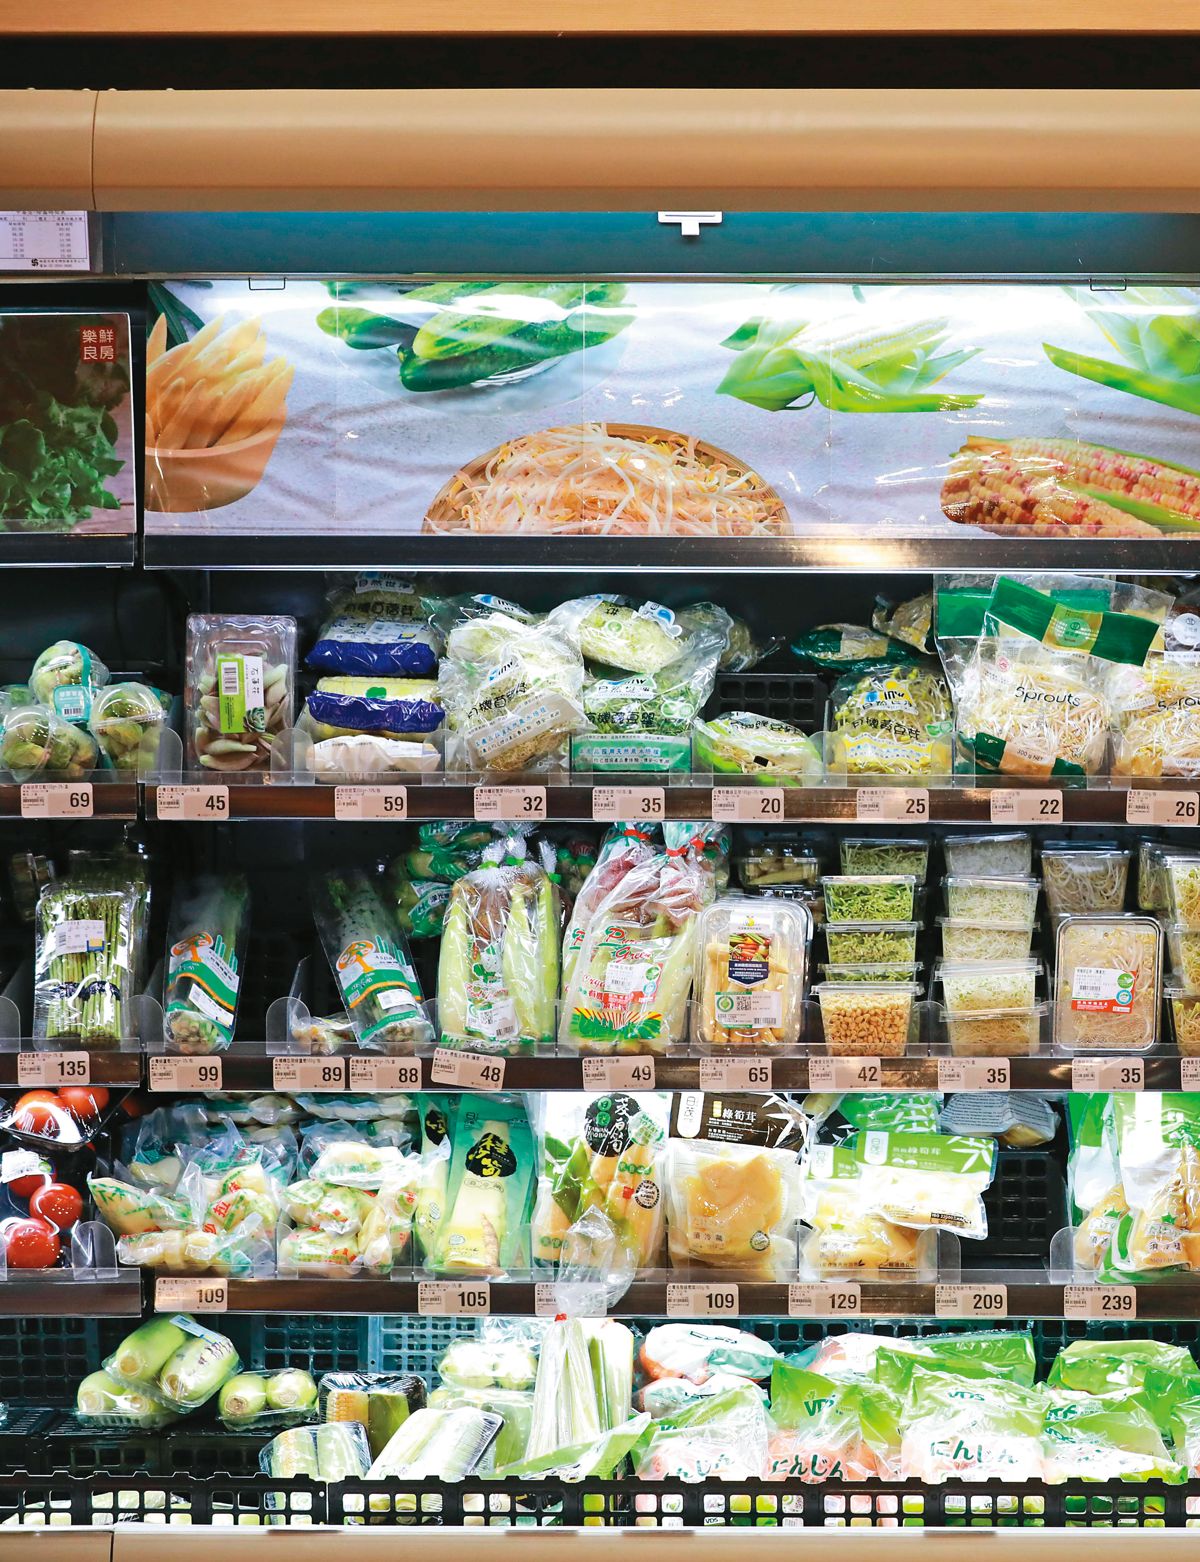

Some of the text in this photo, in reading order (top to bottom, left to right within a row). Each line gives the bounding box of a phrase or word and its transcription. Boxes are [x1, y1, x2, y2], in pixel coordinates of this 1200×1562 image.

[1015, 686, 1082, 707] Sprouts
[69, 792, 90, 808] 69
[205, 795, 226, 811] 45
[383, 796, 404, 812] 59
[523, 795, 543, 812] 32
[641, 797, 662, 814] 35
[760, 797, 781, 814] 20
[905, 798, 926, 814] 25
[1039, 799, 1060, 815] 22
[1175, 800, 1196, 817] 26
[57, 1060, 88, 1077] 135
[198, 1065, 219, 1082] 99
[322, 1066, 343, 1082] 89
[398, 1067, 419, 1084] 88
[479, 1065, 502, 1083] 48
[631, 1065, 652, 1081] 49
[748, 1067, 769, 1083] 65
[857, 1066, 878, 1082] 42
[986, 1068, 1007, 1084] 35
[1120, 1067, 1141, 1084] 35
[722, 1108, 757, 1122] 綠筍茸
[196, 1288, 225, 1304] 109
[457, 1291, 487, 1307] 105
[705, 1292, 735, 1309] 109
[828, 1293, 857, 1310] 129
[973, 1293, 1003, 1310] 209
[1102, 1294, 1133, 1311] 239
[771, 1454, 848, 1480] にんじん
[705, 1516, 719, 1524] VDS
